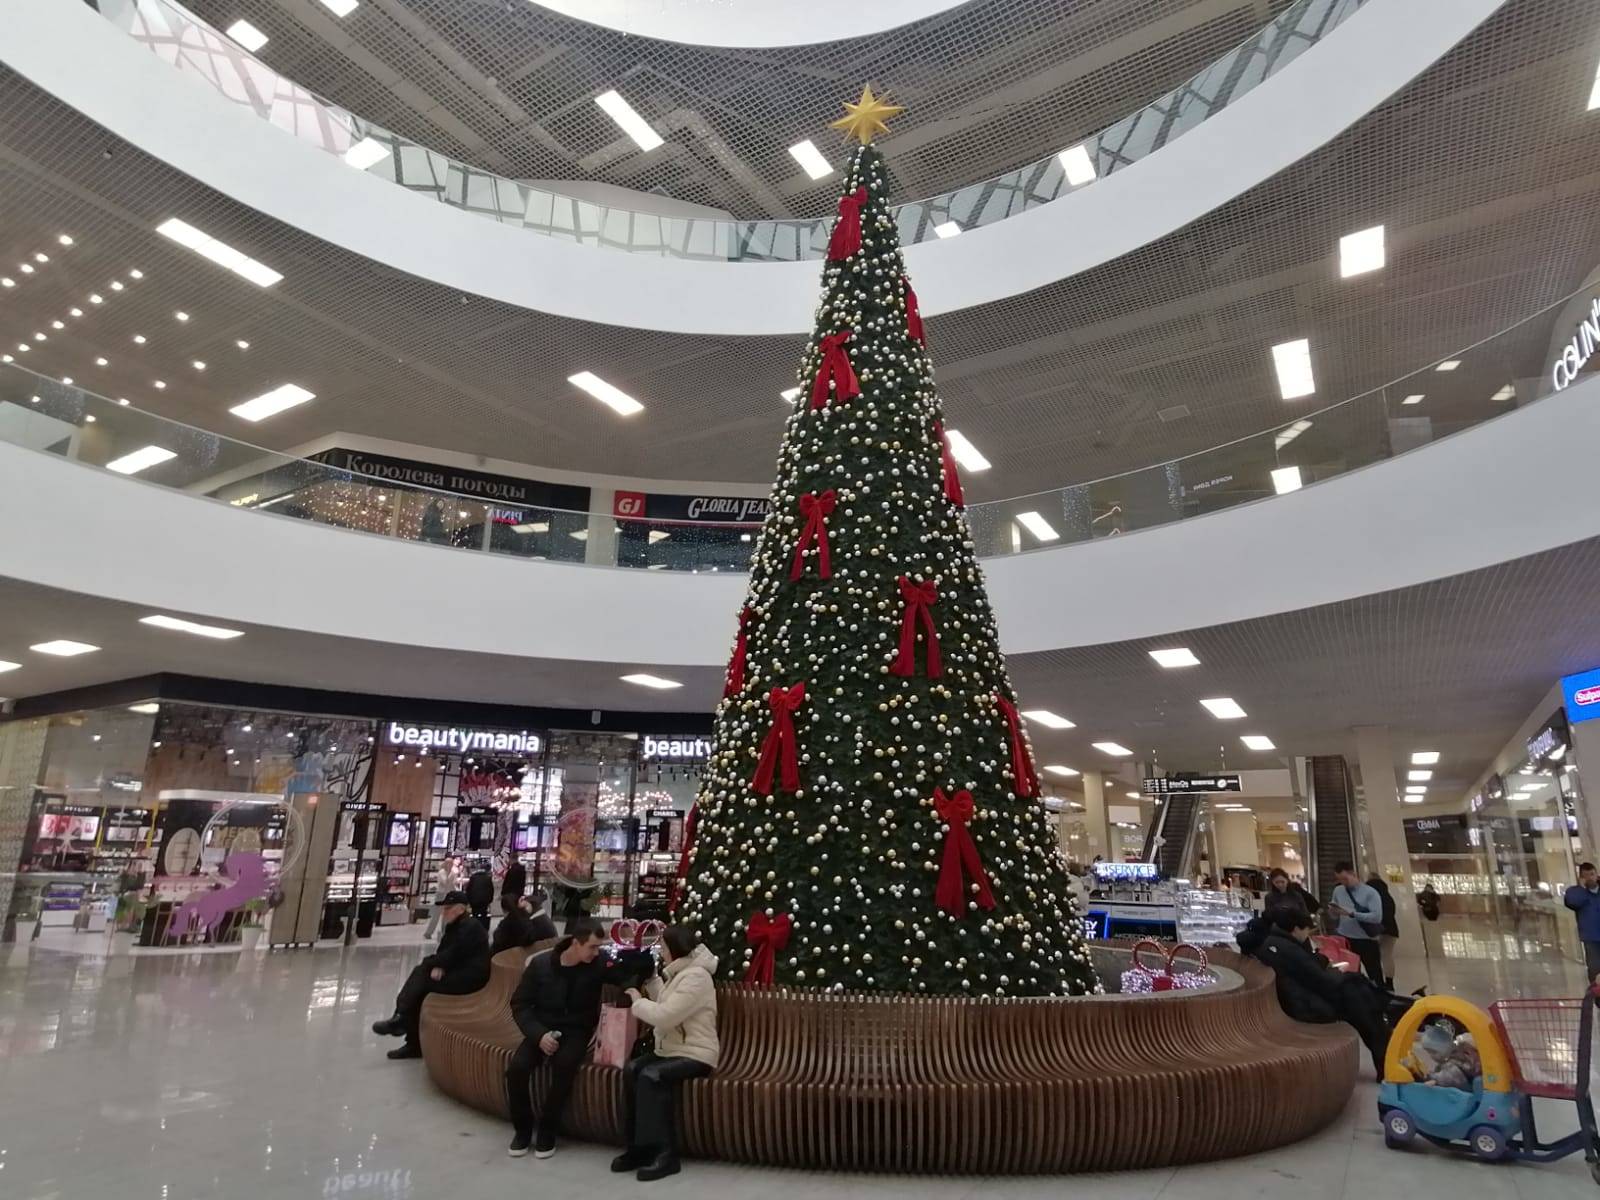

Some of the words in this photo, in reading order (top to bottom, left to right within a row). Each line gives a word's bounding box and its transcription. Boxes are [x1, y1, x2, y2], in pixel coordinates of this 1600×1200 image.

[345, 453, 445, 486] Королева
[450, 476, 526, 499] погоды
[618, 498, 641, 514] GJ
[687, 497, 739, 519] GLORIA
[389, 721, 540, 753] beautymania
